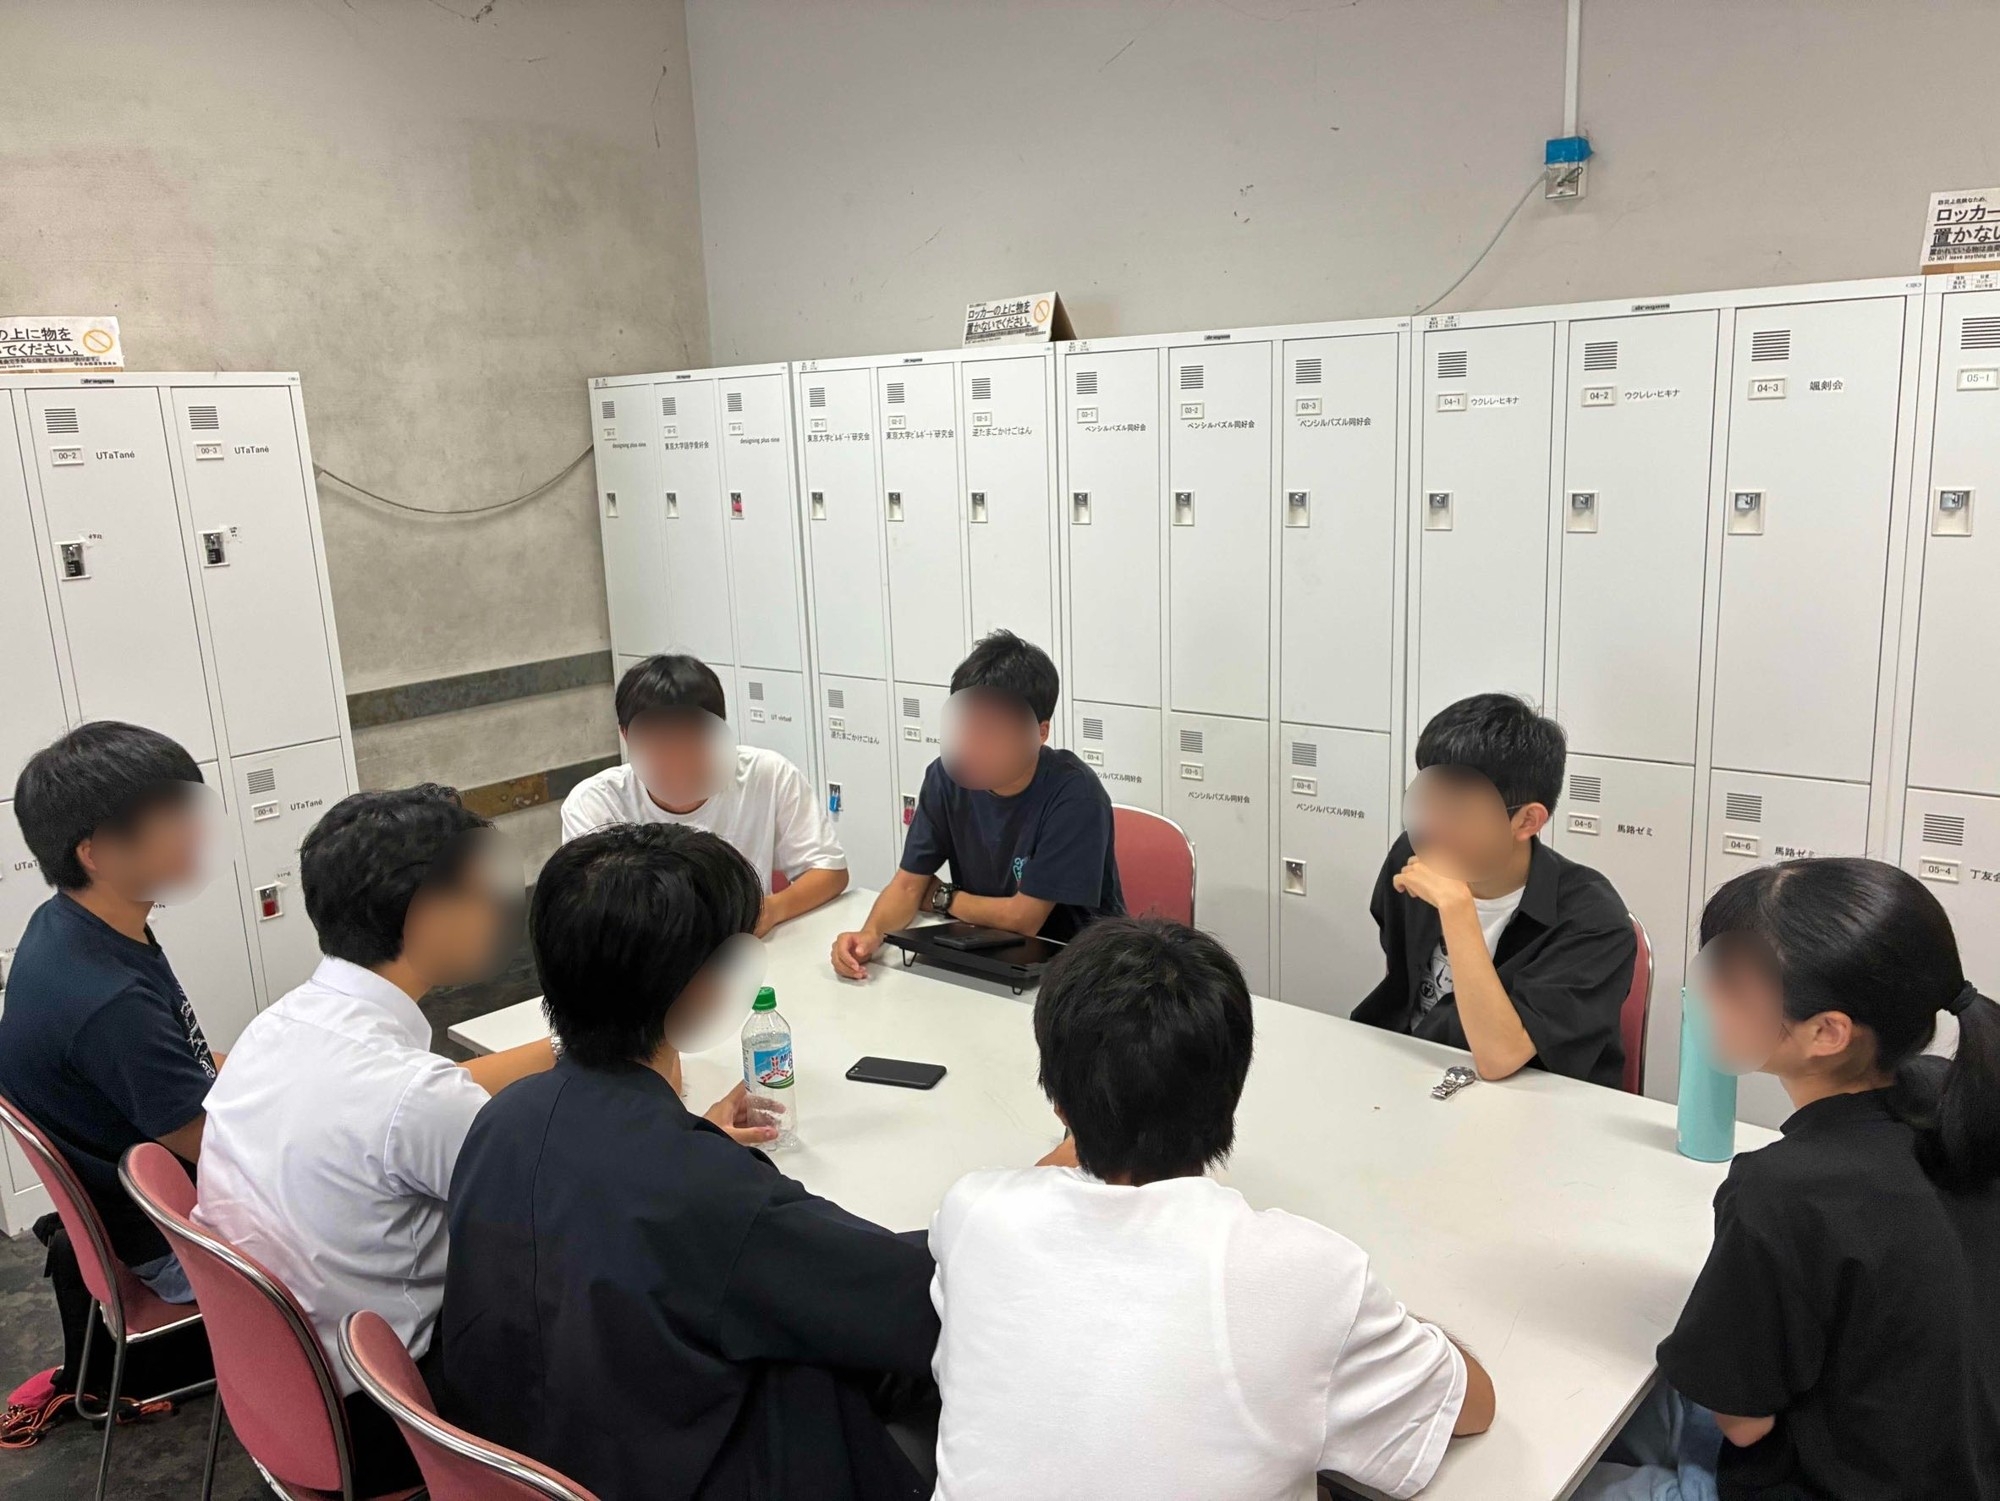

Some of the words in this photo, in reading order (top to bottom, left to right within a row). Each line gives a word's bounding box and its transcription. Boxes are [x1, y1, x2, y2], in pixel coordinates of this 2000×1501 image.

[0, 343, 79, 356] でください。
[1966, 374, 1990, 383] 05-1
[1757, 383, 1779, 393] 04-3
[1590, 391, 1609, 400] 04-2
[1301, 402, 1317, 410] 03-3
[1444, 398, 1461, 406] 04-1
[1185, 406, 1199, 415] 03-2
[1187, 420, 1255, 430] ペンシルパズル同好会
[1299, 417, 1372, 428] ペンシルパズル同好会
[96, 450, 135, 460] UTaTané
[201, 447, 218, 455] 00-3
[234, 446, 270, 455] UTaTané
[58, 452, 77, 460] 00-2
[1574, 820, 1593, 829] 04-5
[1617, 824, 1653, 837] 馬路ゼミ
[1730, 840, 1751, 850] 04-6
[14, 860, 39, 871] UTaT
[1928, 865, 1951, 875] 05-4
